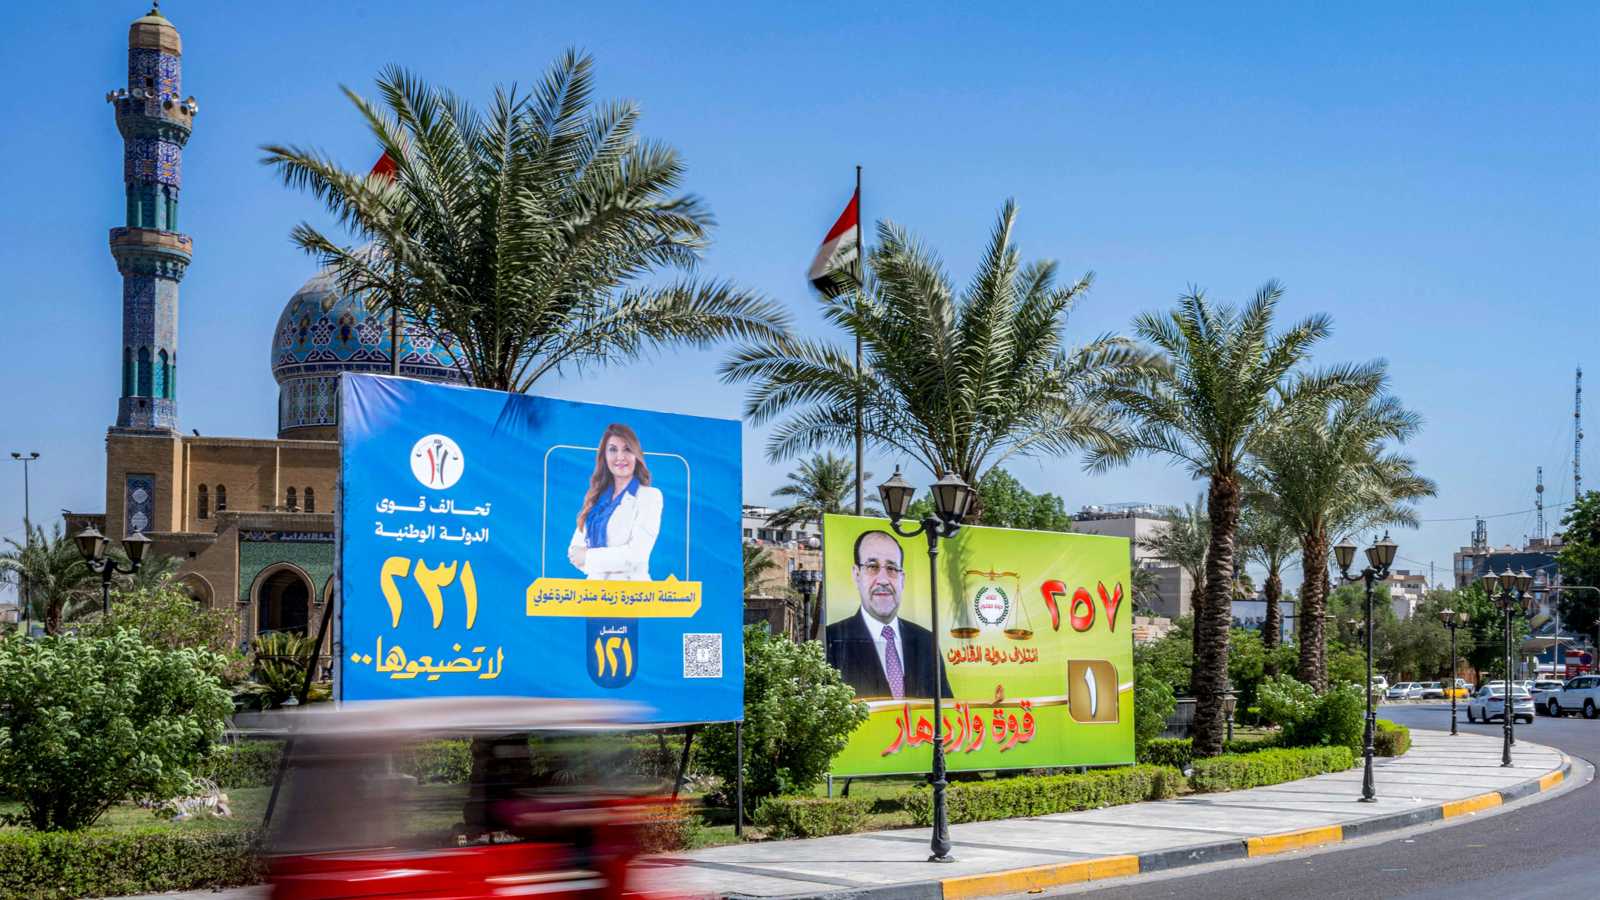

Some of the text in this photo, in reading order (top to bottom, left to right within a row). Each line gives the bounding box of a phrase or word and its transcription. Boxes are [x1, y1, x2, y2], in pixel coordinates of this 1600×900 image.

[375, 495, 492, 516] تحالف قوى
[374, 521, 490, 545] الدولة الوطنية
[380, 556, 479, 630] ٢٣١
[621, 590, 655, 606] الدكتورة
[658, 589, 696, 603] المستقلة
[1041, 579, 1125, 633] ٢٥٧
[594, 636, 633, 678] ١٢١
[880, 700, 1036, 757] قوة وازدهار
